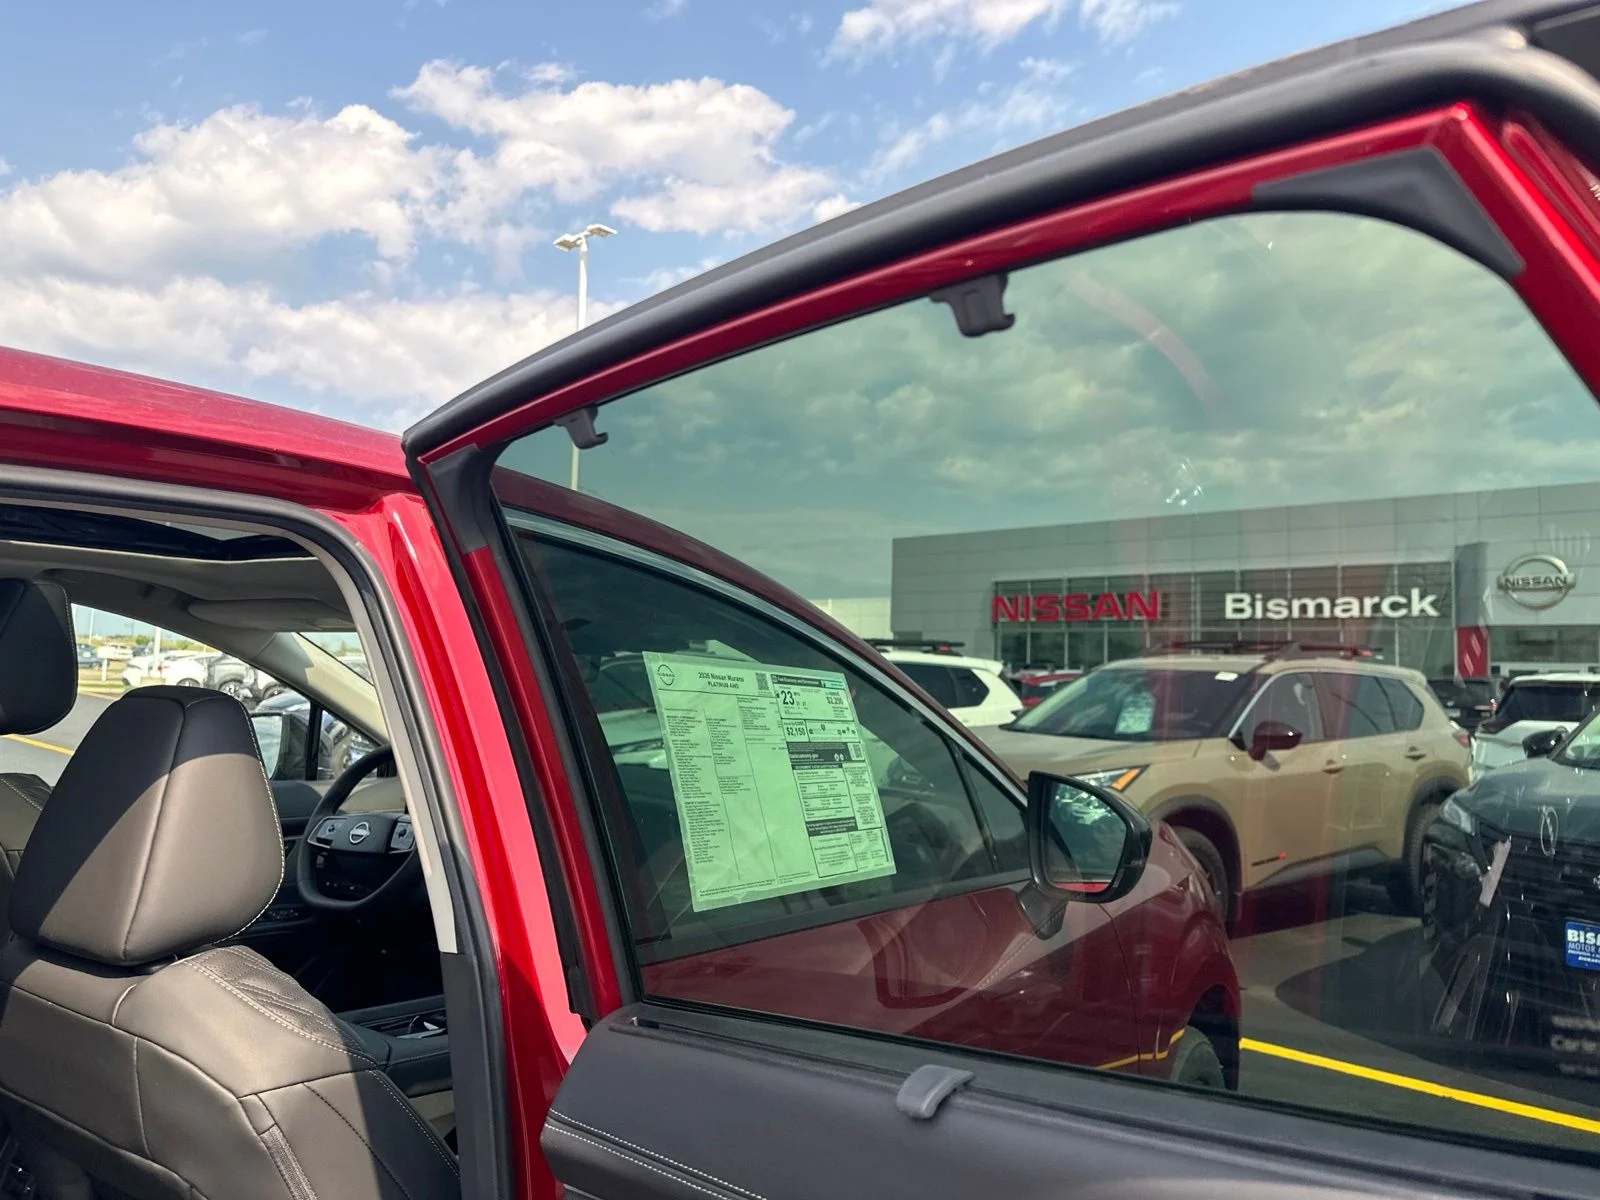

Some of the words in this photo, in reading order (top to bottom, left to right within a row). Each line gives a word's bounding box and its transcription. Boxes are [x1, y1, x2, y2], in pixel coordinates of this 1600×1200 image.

[1504, 576, 1567, 591] NISSAN
[992, 590, 1161, 622] NISSAN
[1224, 587, 1440, 620] Bismarck
[780, 690, 795, 705] 23
[1568, 942, 1596, 953] MOTOR
